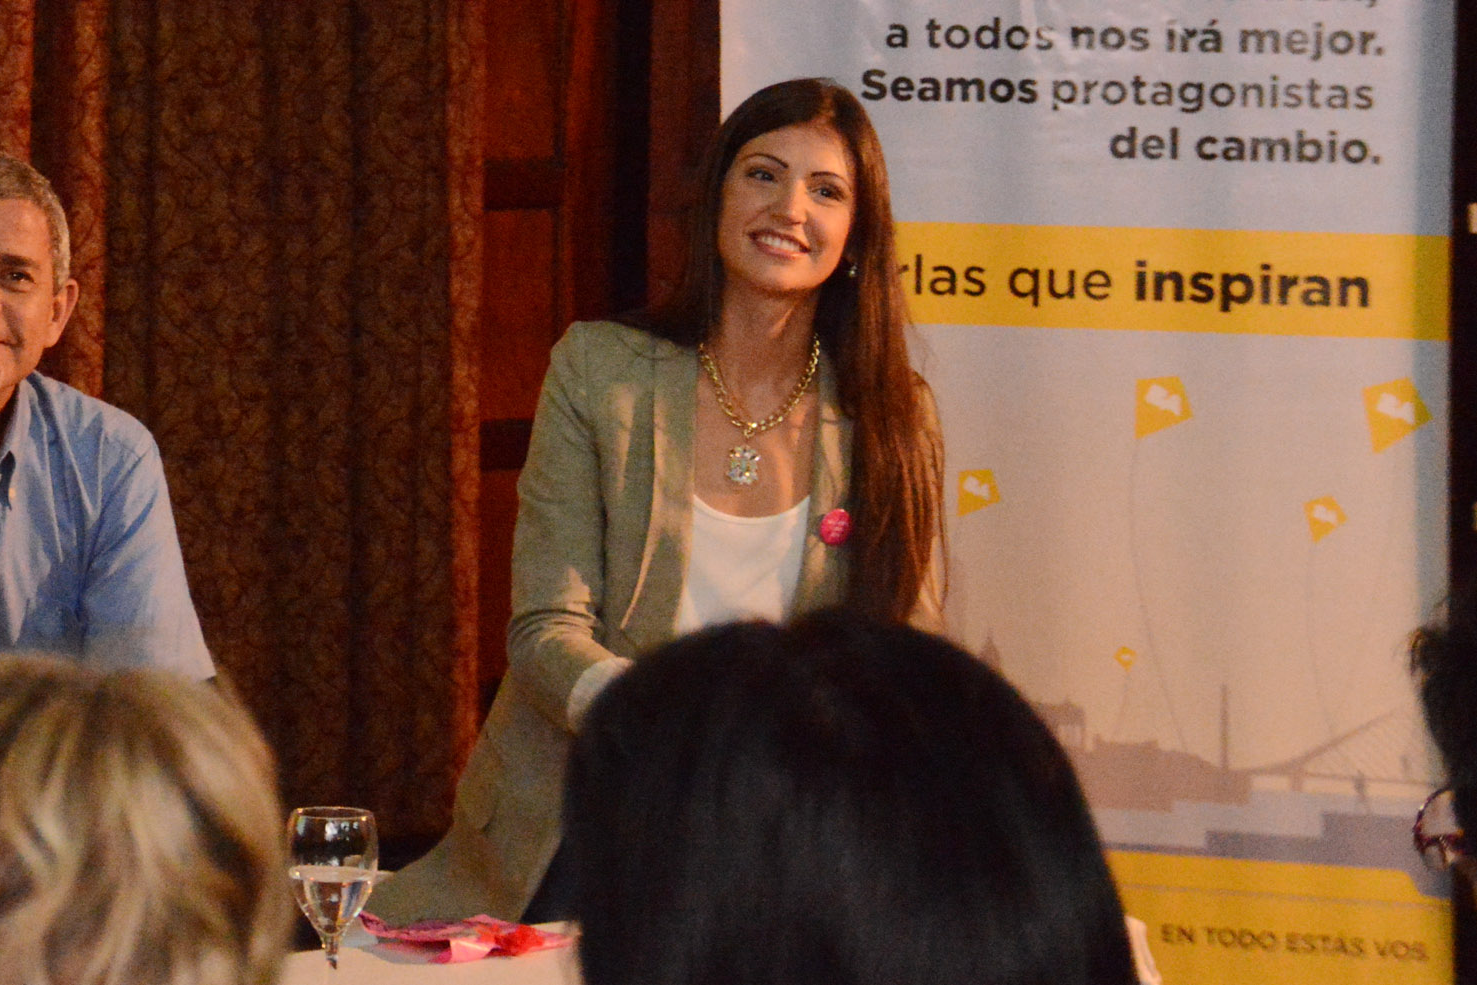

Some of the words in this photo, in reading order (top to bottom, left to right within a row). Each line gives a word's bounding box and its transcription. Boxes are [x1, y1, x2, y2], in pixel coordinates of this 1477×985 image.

[886, 22, 909, 50] a
[926, 17, 1054, 52] todos
[1070, 25, 1150, 52] nos
[1165, 19, 1222, 54] irá
[1239, 22, 1385, 62] mejor.
[861, 69, 1038, 104] Seamos
[1052, 73, 1374, 113] protagonistas
[1110, 126, 1179, 161] del
[1195, 130, 1380, 165] cambio.
[1008, 266, 1112, 308] que
[1135, 259, 1370, 314] inspiran
[1161, 923, 1195, 944] EN
[1202, 926, 1278, 951] TODO
